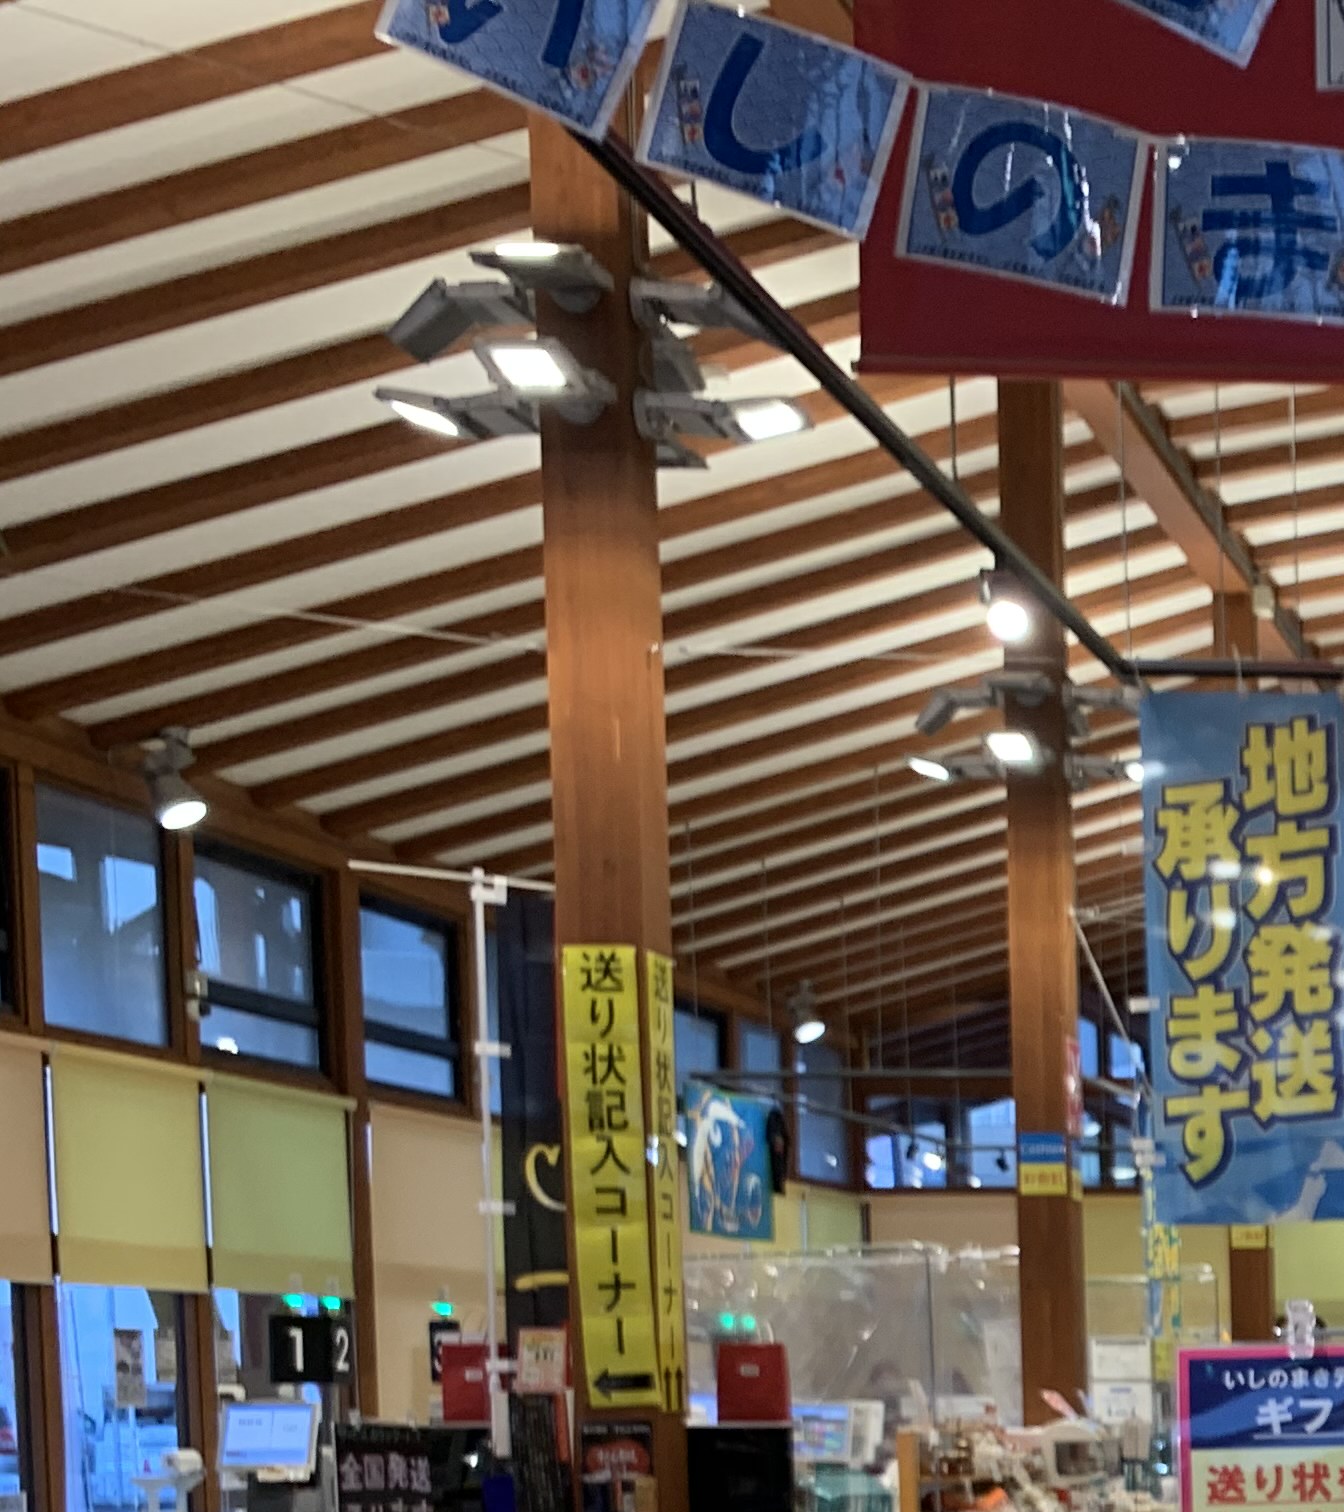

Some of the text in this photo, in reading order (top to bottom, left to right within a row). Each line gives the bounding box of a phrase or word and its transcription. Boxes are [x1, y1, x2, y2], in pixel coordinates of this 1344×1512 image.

[1154, 780, 1250, 1184] 承ります
[1241, 718, 1337, 1121] 地方発送
[287, 1326, 305, 1374] 1
[333, 1327, 351, 1373] 2
[580, 951, 638, 1356] 送り状記入コーナー
